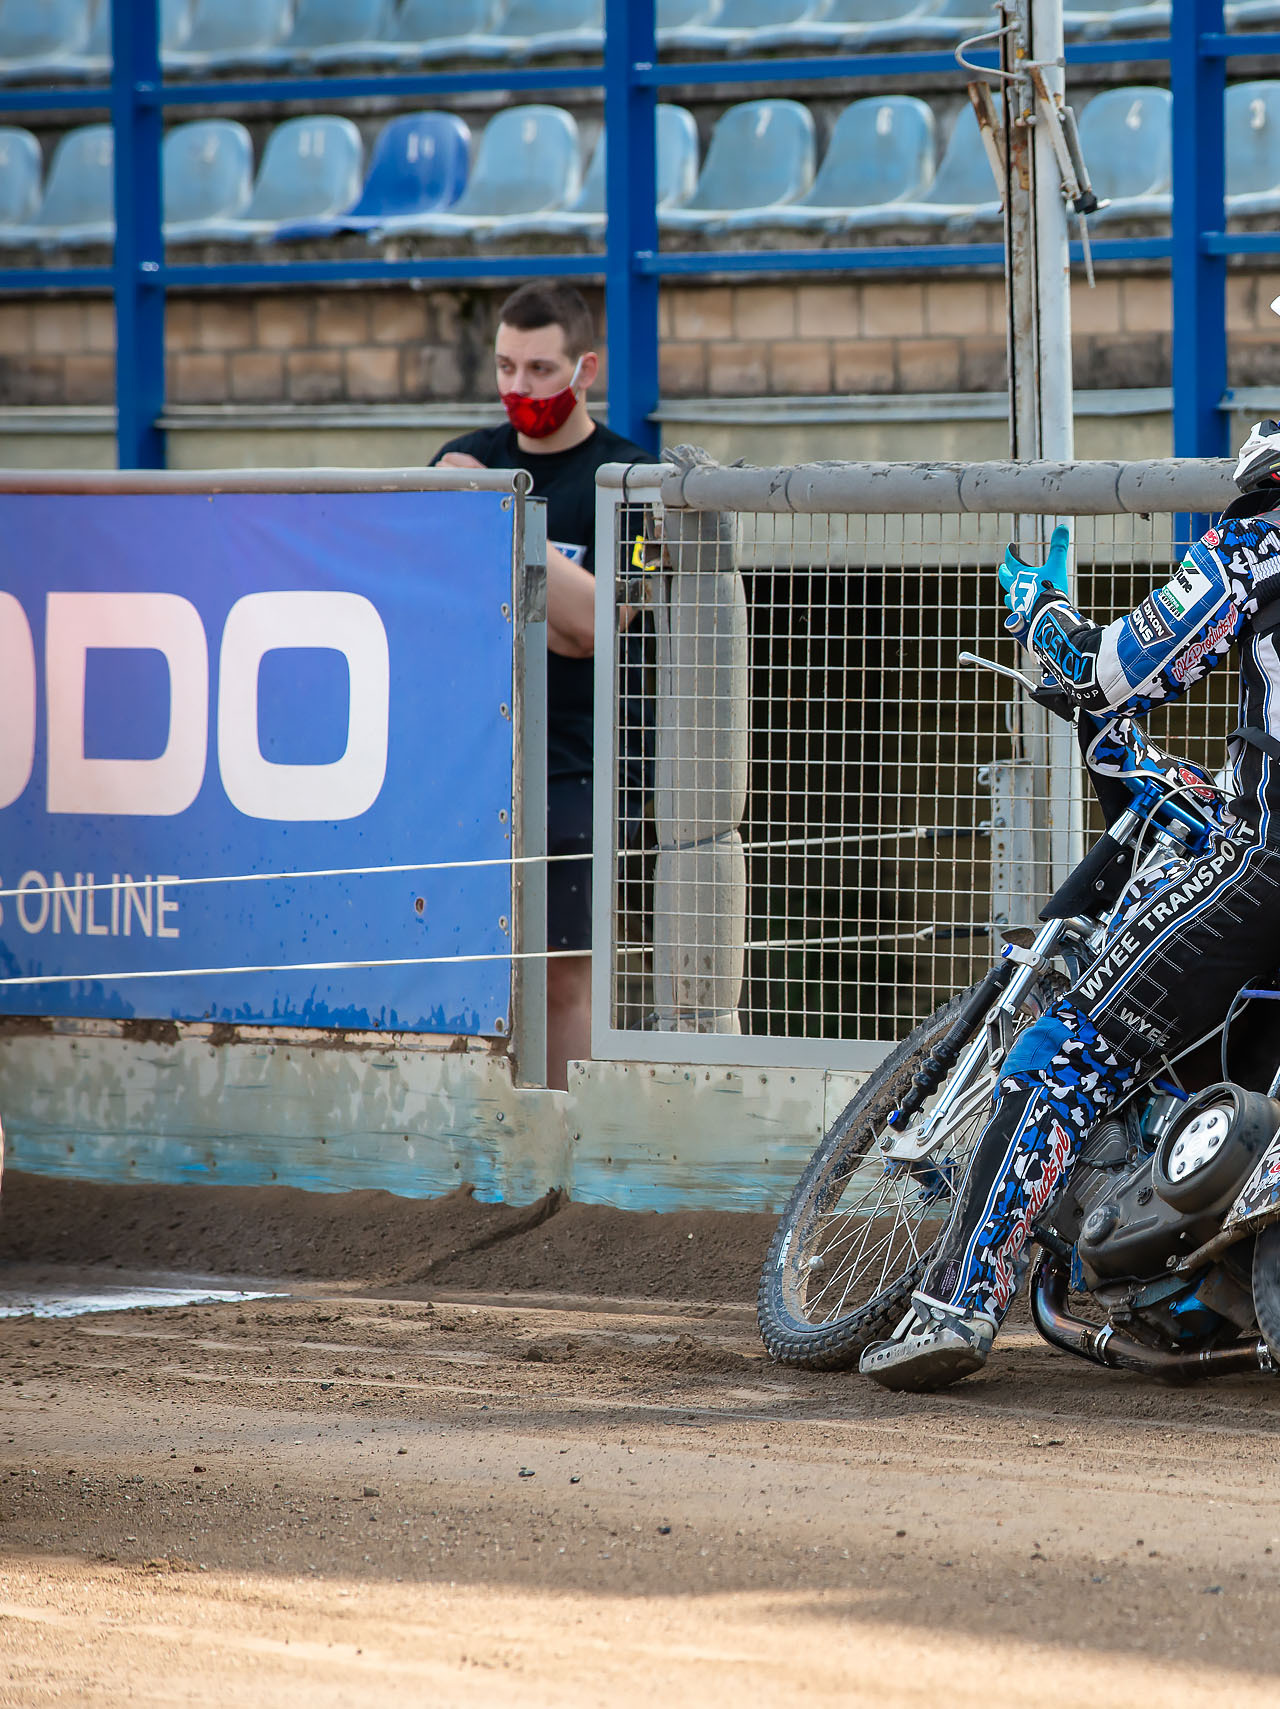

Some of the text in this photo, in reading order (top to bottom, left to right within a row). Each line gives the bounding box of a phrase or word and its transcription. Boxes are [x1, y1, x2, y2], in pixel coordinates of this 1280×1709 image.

[1143, 602, 1165, 637] DIXON
[16, 870, 180, 938] ONLINE
[1079, 931, 1140, 1000] WYEE
[1119, 1007, 1171, 1047] WYEE
